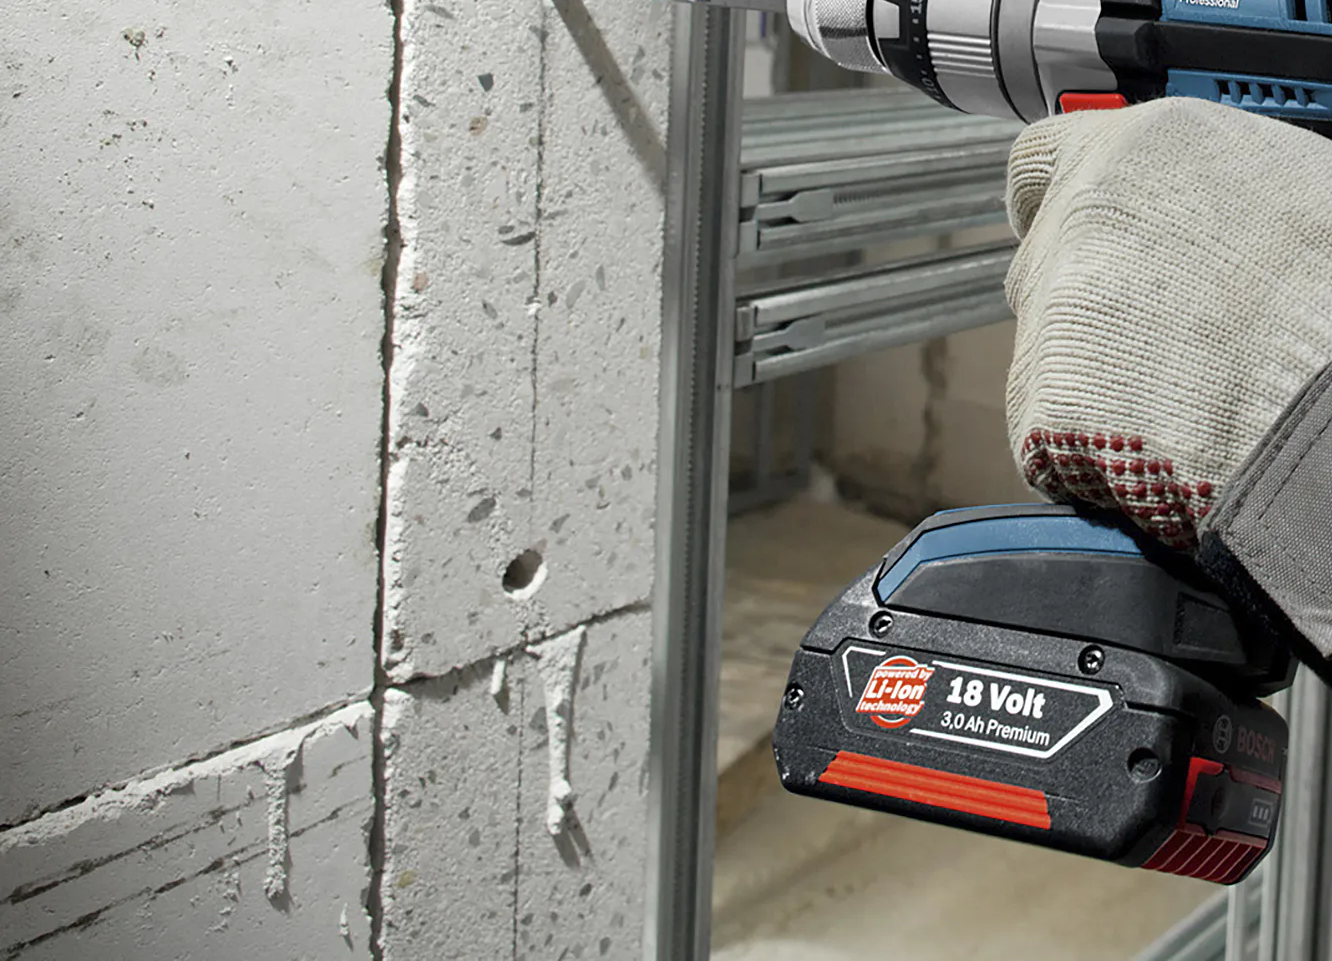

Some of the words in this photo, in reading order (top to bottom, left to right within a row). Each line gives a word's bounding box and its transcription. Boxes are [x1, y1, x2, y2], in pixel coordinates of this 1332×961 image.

[874, 669, 918, 680] powered
[918, 669, 933, 681] by
[865, 679, 925, 701] Li-Ion
[946, 676, 984, 707] 18
[989, 683, 1047, 719] Volt
[860, 700, 923, 715] technology
[964, 715, 985, 734] Ah
[986, 718, 1050, 747] Premium
[1237, 719, 1275, 765] BOSCH
